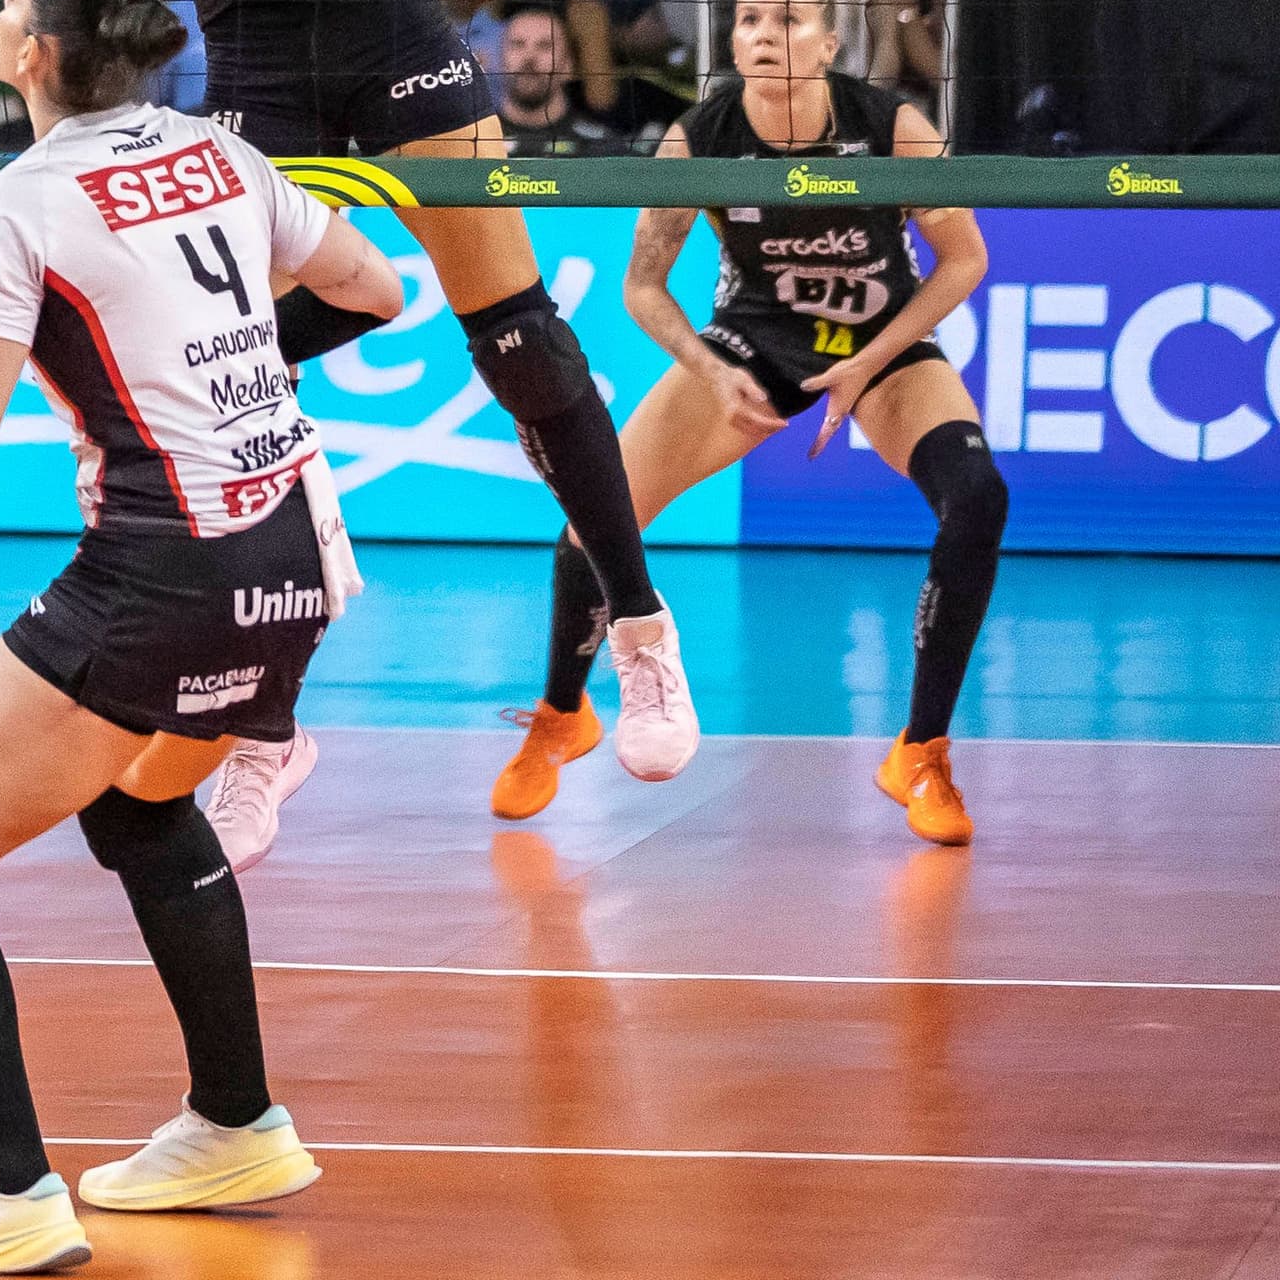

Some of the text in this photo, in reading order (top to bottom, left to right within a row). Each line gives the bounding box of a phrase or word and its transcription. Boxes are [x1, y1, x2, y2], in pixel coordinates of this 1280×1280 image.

[111, 132, 163, 155] PENALTY
[107, 150, 230, 221] SESI
[509, 180, 560, 194] BRASIL
[807, 180, 860, 194] BRASIL
[1130, 179, 1183, 193] BRASIL
[175, 224, 252, 317] 4
[793, 276, 868, 315] BH
[495, 329, 523, 354] N1
[233, 580, 324, 627] Unim
[178, 666, 265, 693] PACAEMBU
